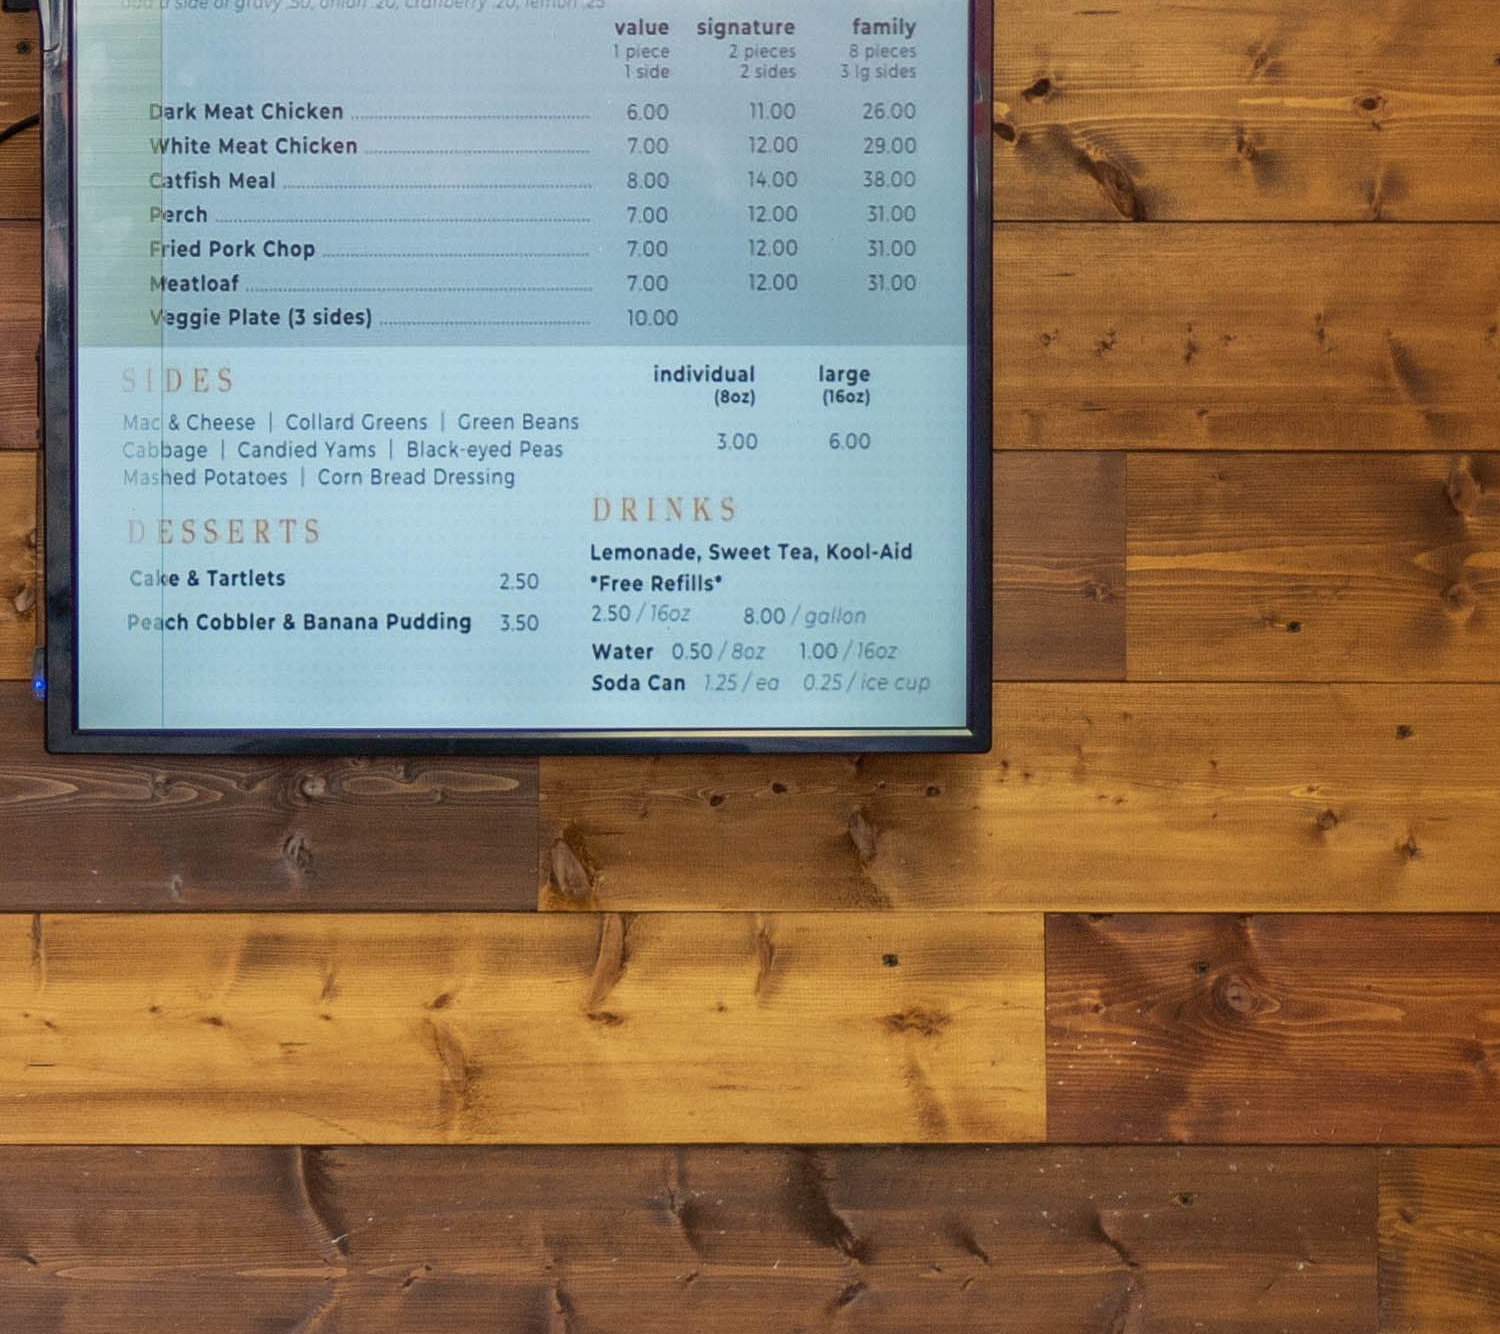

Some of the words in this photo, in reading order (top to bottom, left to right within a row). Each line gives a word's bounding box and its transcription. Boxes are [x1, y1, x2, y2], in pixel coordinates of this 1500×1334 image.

[614, 17, 670, 36] value
[696, 16, 796, 41] signature
[852, 16, 917, 40] family
[149, 102, 197, 121] Dark
[204, 103, 254, 121] Meat
[261, 101, 344, 121] Chicken
[626, 102, 670, 121] 6.00
[749, 101, 797, 121] 11.00
[862, 101, 917, 120] 26.00
[150, 135, 211, 155] White
[218, 137, 268, 155] Meat
[275, 135, 358, 155] Chicken
[149, 170, 221, 190] Catfish
[228, 171, 276, 190] Meal
[150, 205, 208, 224] Perch
[150, 238, 201, 258] Fried
[209, 239, 256, 258] Pork
[262, 239, 316, 262] Chop
[150, 273, 240, 293] Meatloaf
[150, 307, 221, 331] Veggie
[228, 307, 281, 326] Plate
[288, 307, 306, 330] (3
[312, 306, 372, 330] sides)
[626, 308, 679, 327] 10.00
[123, 367, 232, 392] SIDES
[653, 364, 755, 383] individual
[818, 364, 871, 387] large
[714, 389, 756, 407] (8oz)
[822, 388, 871, 407] (16oz)
[123, 413, 164, 431] Mac
[168, 413, 180, 432] &
[186, 413, 256, 432] Cheese
[285, 412, 355, 431] Collard
[361, 412, 428, 431] Greens
[457, 412, 515, 431] Green
[522, 412, 580, 431] Beans
[121, 439, 208, 463] Cabbage
[237, 440, 318, 459] Candied
[324, 441, 377, 459] Yams
[407, 439, 512, 462] Black-eyed
[519, 439, 564, 459] Peas
[716, 432, 759, 451] 3.00
[828, 432, 872, 451] 6.00
[123, 467, 197, 488] Mashed
[204, 468, 288, 486] Potatoes
[317, 467, 363, 486] Corn
[370, 467, 426, 486] Bread
[433, 467, 516, 490] Dressing
[593, 495, 735, 523] DRINKS
[128, 518, 319, 544] DESSERTS
[590, 543, 702, 563] Lemonade,
[708, 543, 771, 561] Sweet
[777, 542, 819, 563] Tea,
[826, 541, 913, 561] Kool-Aid
[129, 569, 180, 588] Cake
[186, 569, 200, 587] &
[206, 568, 286, 587] Tartlets
[127, 612, 189, 632] Peach
[196, 612, 276, 631] Cobbler
[282, 613, 296, 631] &
[303, 612, 379, 631] Banana
[386, 611, 472, 635] Pudding
[591, 643, 654, 661] Water
[591, 673, 641, 692] Soda
[647, 673, 686, 692] Can
